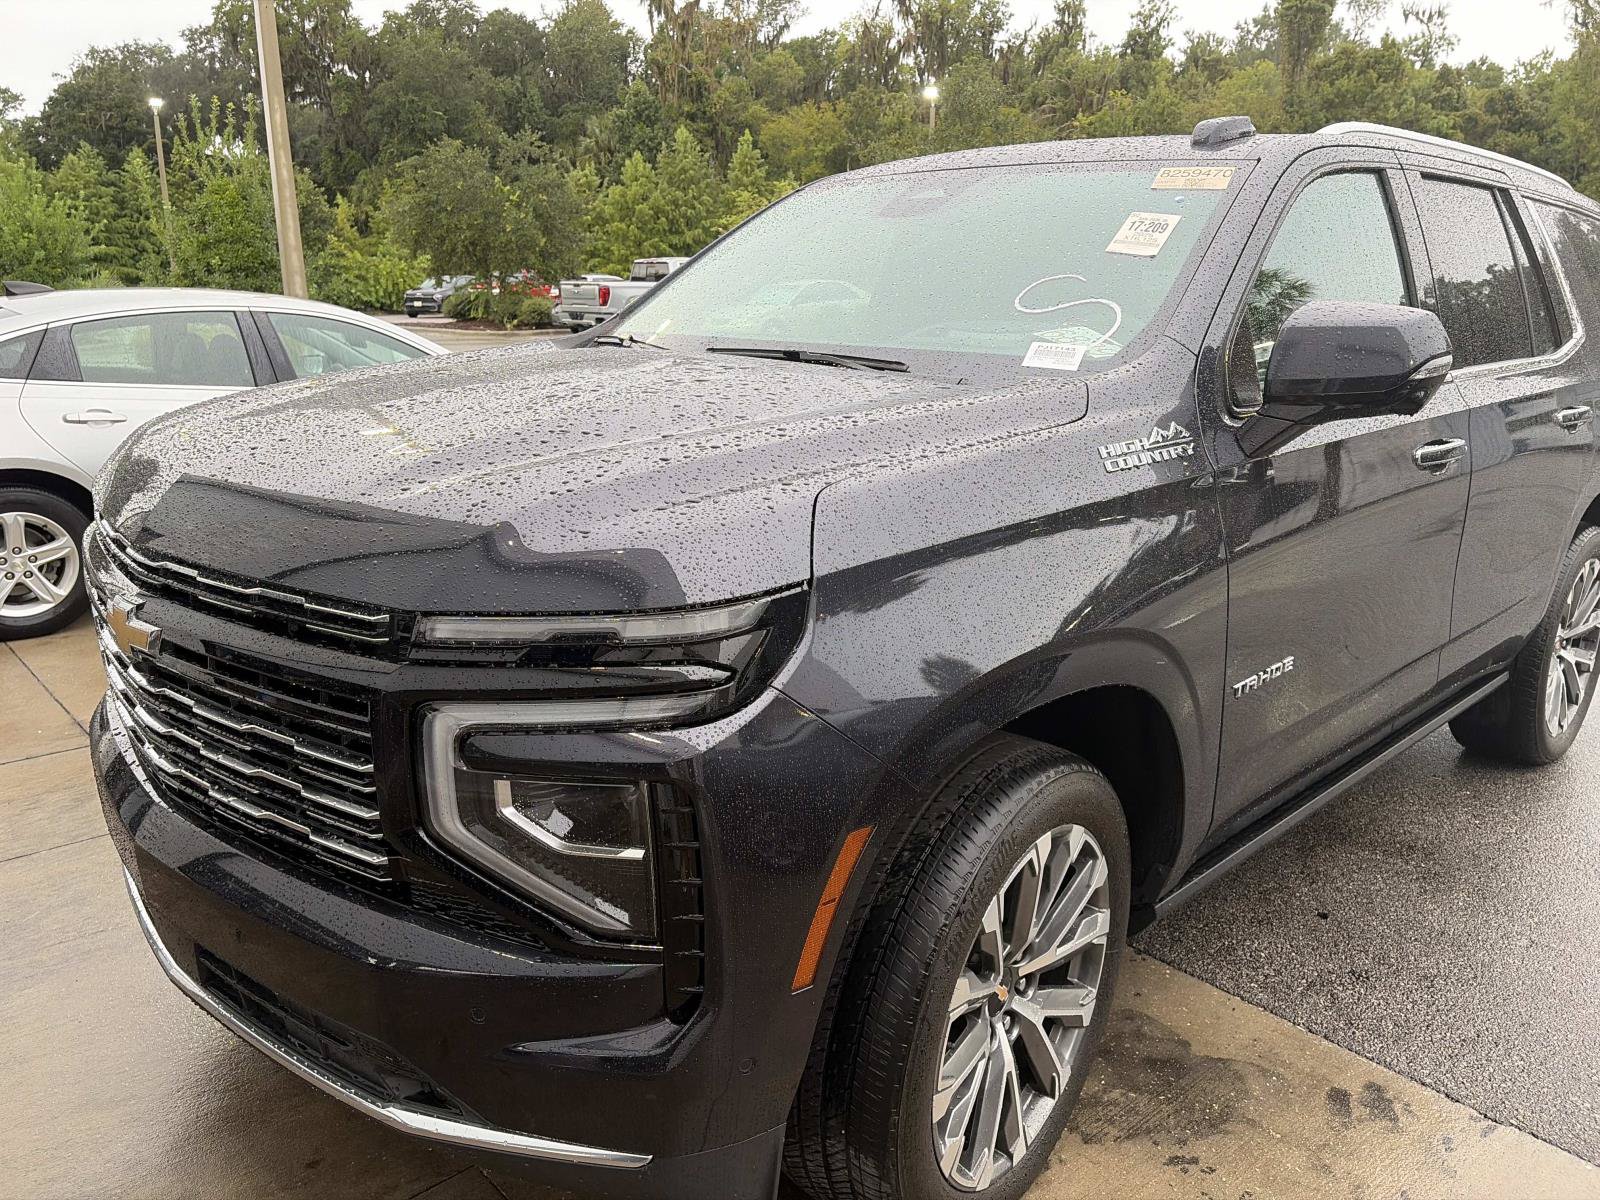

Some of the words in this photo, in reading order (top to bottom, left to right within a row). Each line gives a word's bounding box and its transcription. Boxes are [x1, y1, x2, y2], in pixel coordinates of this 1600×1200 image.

[1160, 168, 1233, 178] 8259470
[1098, 437, 1150, 459] HIGH
[1103, 442, 1194, 473] COUNTRY
[1232, 655, 1295, 698] TAHOE
